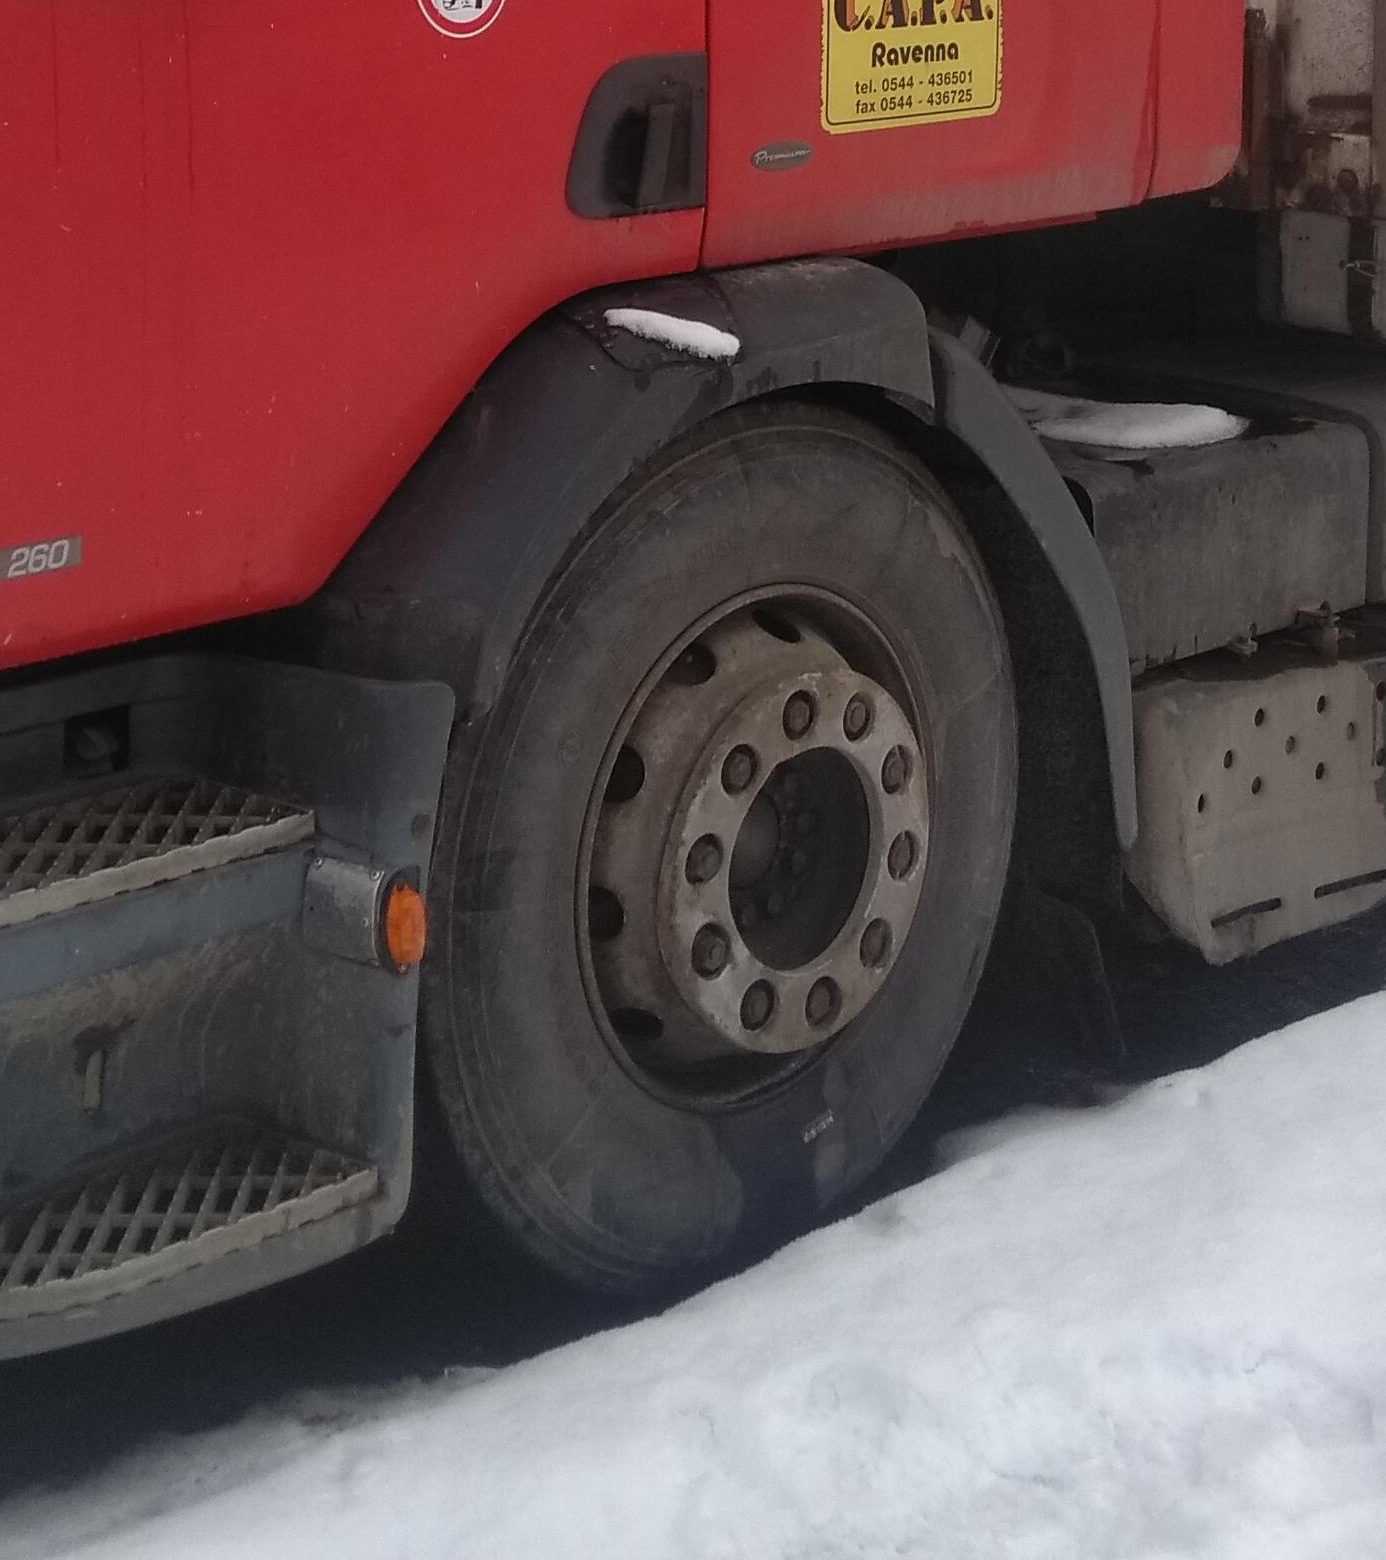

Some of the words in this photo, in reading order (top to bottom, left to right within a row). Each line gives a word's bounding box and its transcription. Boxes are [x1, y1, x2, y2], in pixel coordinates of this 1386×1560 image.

[871, 42, 959, 68] Ravenna
[855, 80, 877, 95] tel.
[881, 75, 914, 93] 0544
[928, 70, 974, 88] 436501
[856, 98, 876, 114] fax
[880, 94, 913, 112] 0544
[927, 88, 973, 106] 436725
[7, 539, 70, 579] 260
